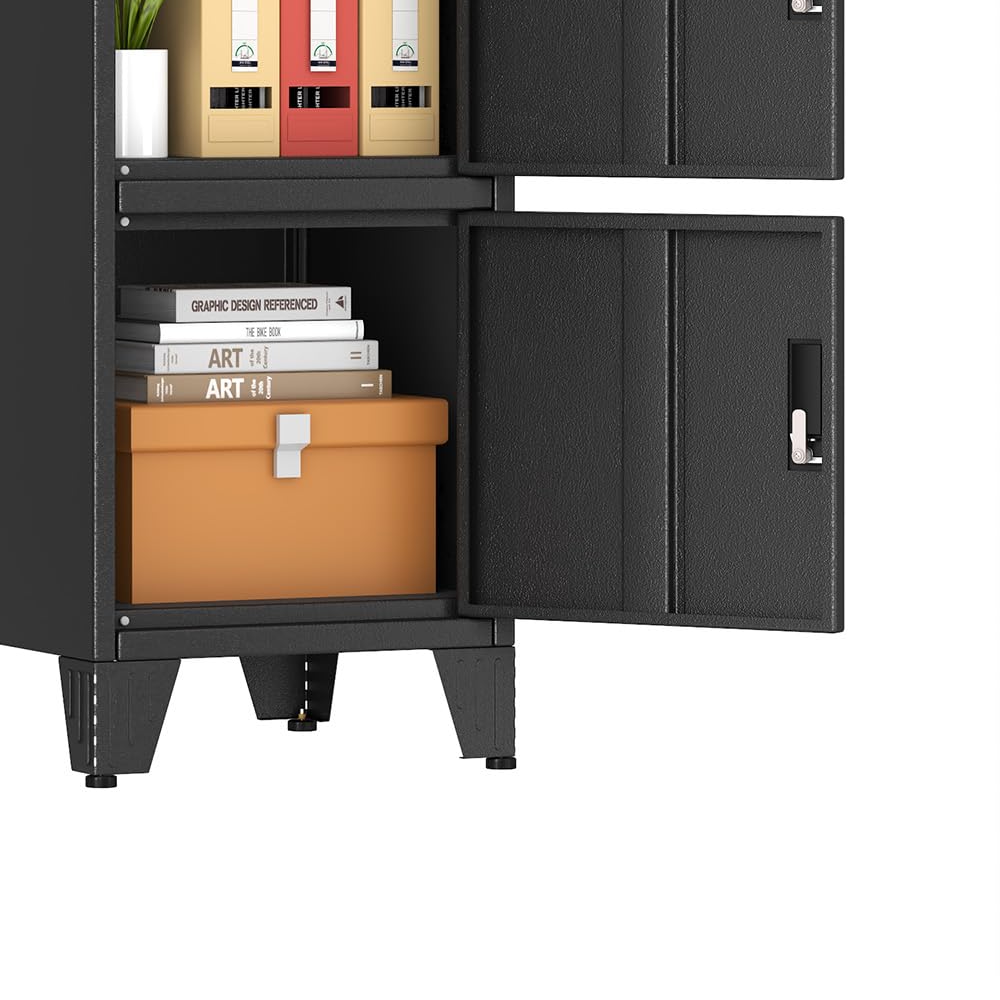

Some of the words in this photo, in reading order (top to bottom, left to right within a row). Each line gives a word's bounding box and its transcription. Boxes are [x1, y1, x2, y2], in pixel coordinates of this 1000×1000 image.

[191, 300, 229, 312] GRAPHIC
[231, 299, 261, 312] DESIGN
[264, 298, 318, 311] REFERENCED
[245, 327, 255, 337] THE
[256, 327, 267, 337] BIKE
[268, 327, 281, 337] BOOK
[208, 347, 243, 369] ART
[205, 377, 245, 399] ART
[265, 375, 273, 400] Century
